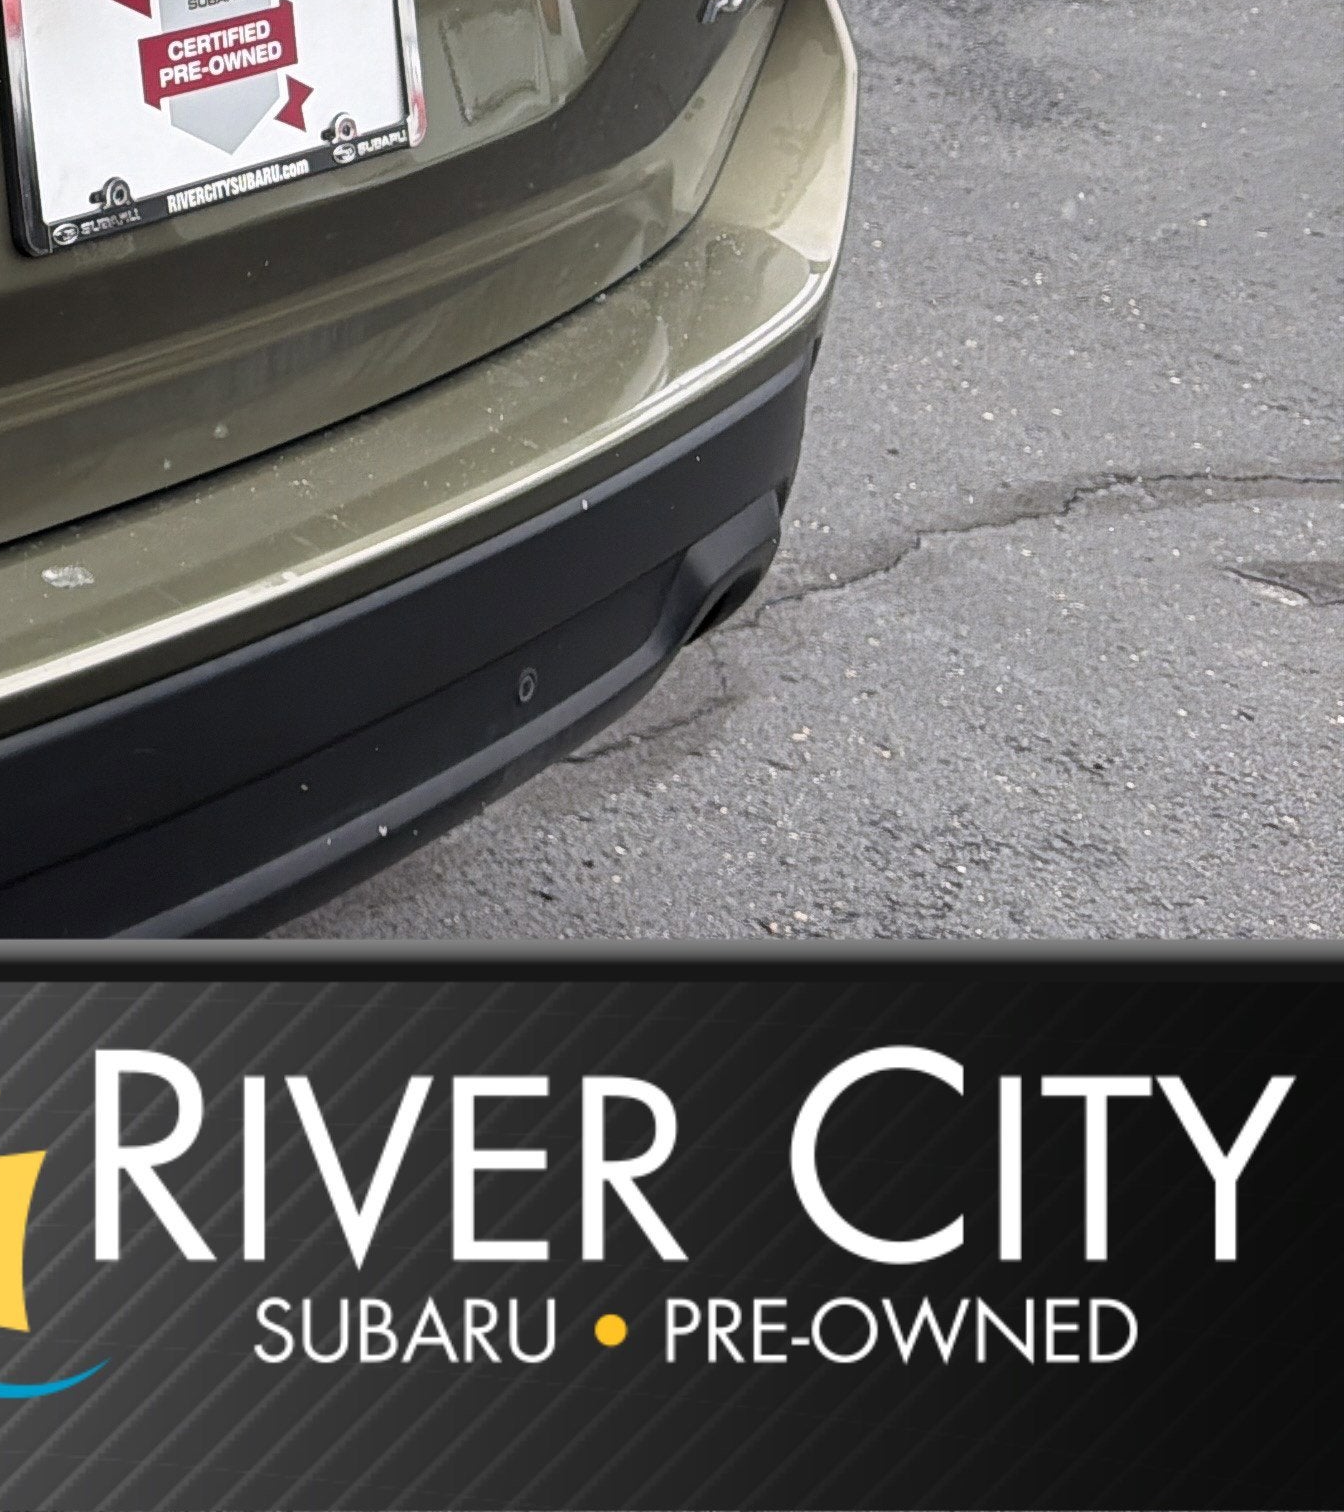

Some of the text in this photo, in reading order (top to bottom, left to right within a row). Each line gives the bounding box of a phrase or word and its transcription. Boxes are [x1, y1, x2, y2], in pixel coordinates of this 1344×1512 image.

[159, 40, 283, 89] PRE-OWNED
[167, 19, 272, 62] CERTIFIED
[166, 158, 311, 214] RIVERCITYSUBARU.com
